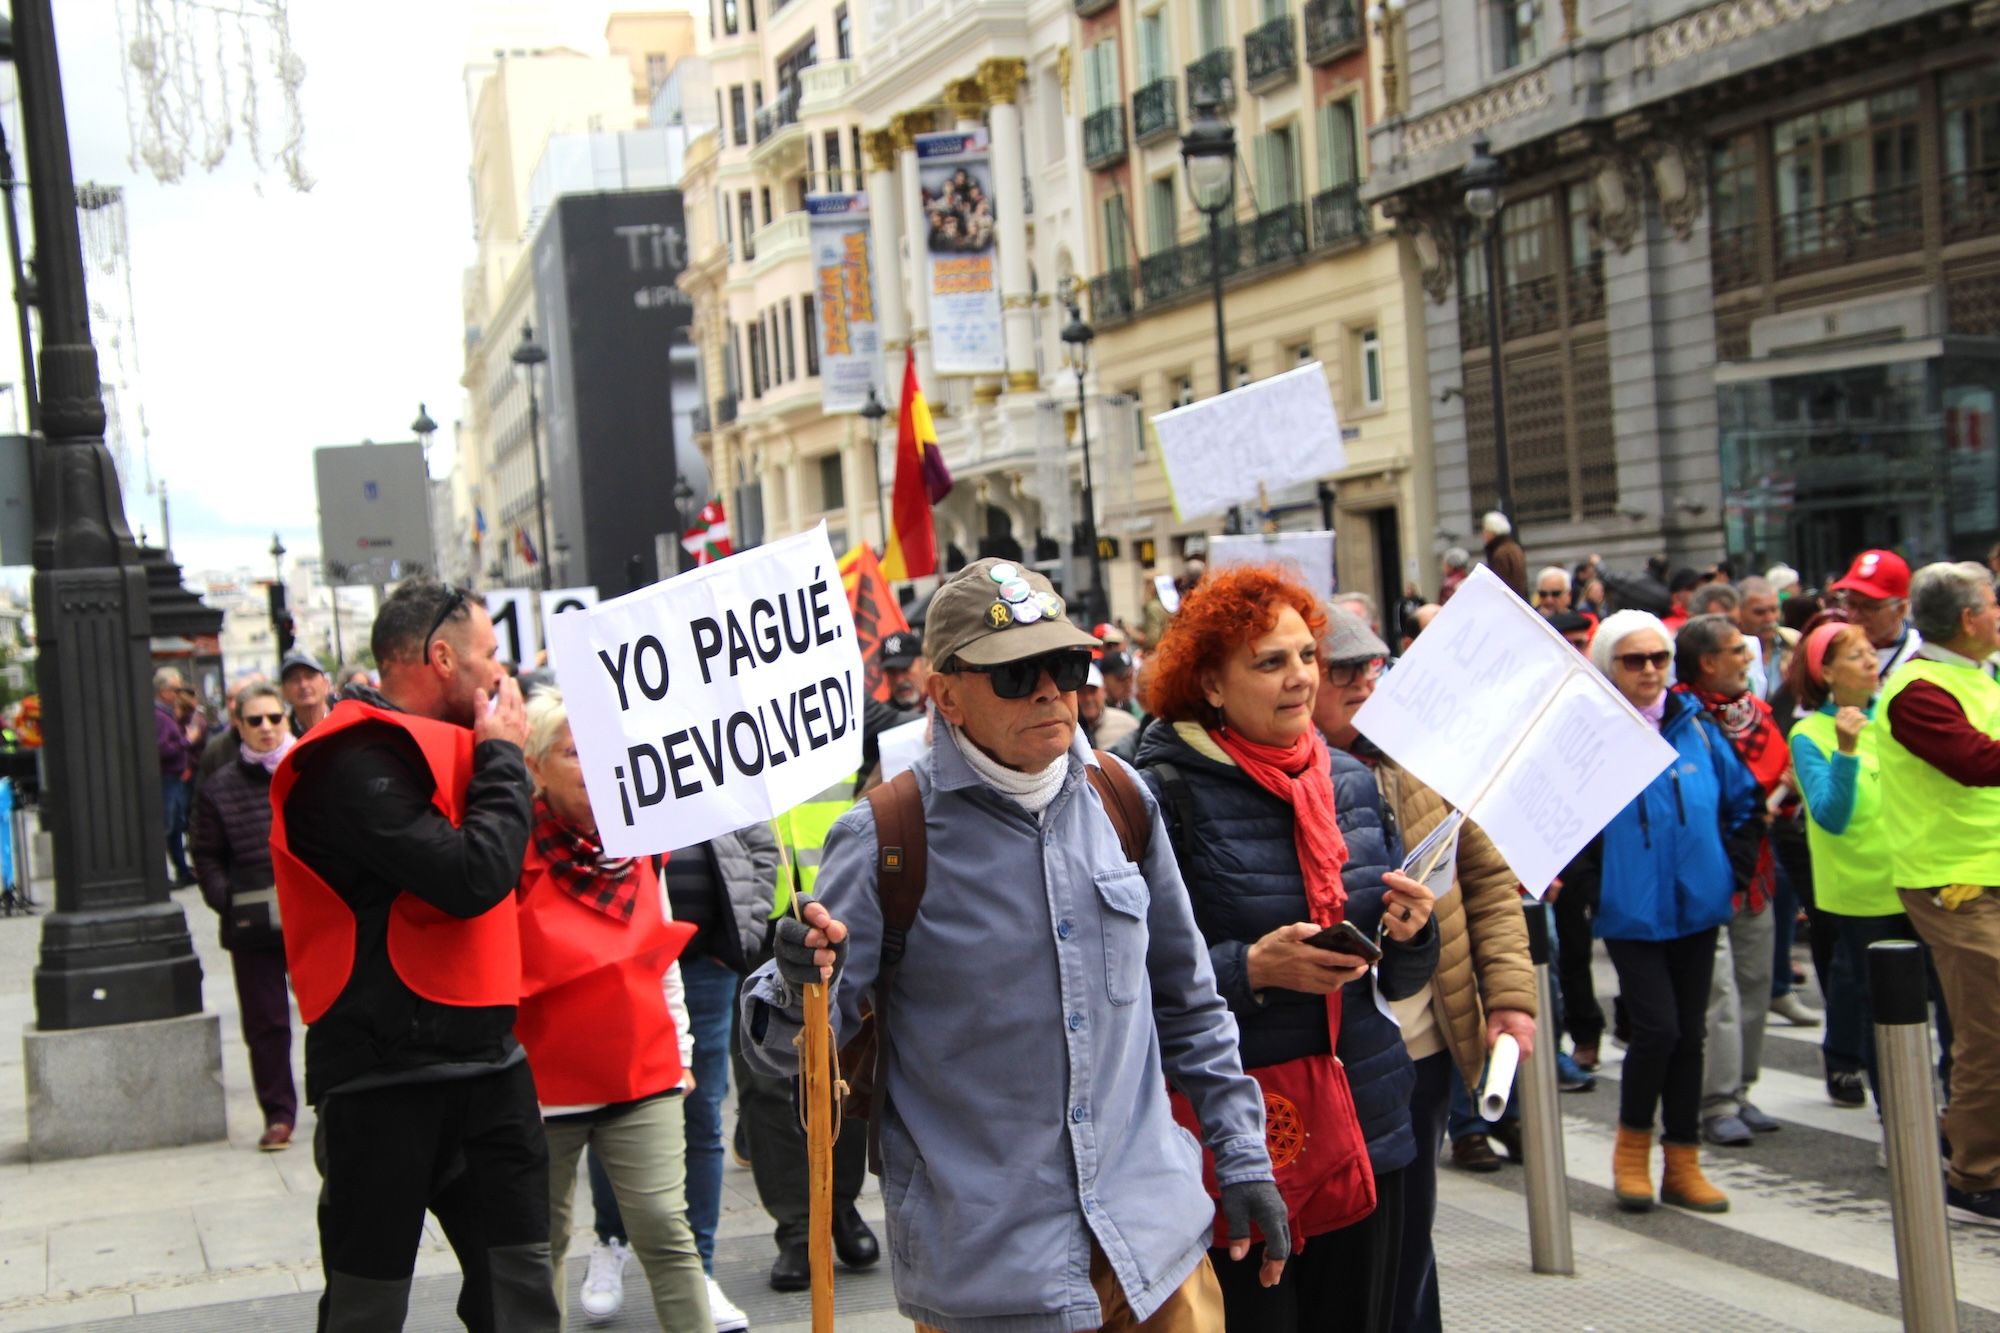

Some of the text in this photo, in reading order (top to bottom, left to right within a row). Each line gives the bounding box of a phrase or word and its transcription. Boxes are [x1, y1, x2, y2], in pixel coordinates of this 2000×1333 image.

[614, 224, 687, 272] Tit
[598, 634, 669, 711] YO
[690, 565, 842, 684] PAGUÉ.
[614, 670, 857, 826] ¡DEVOLVED!
